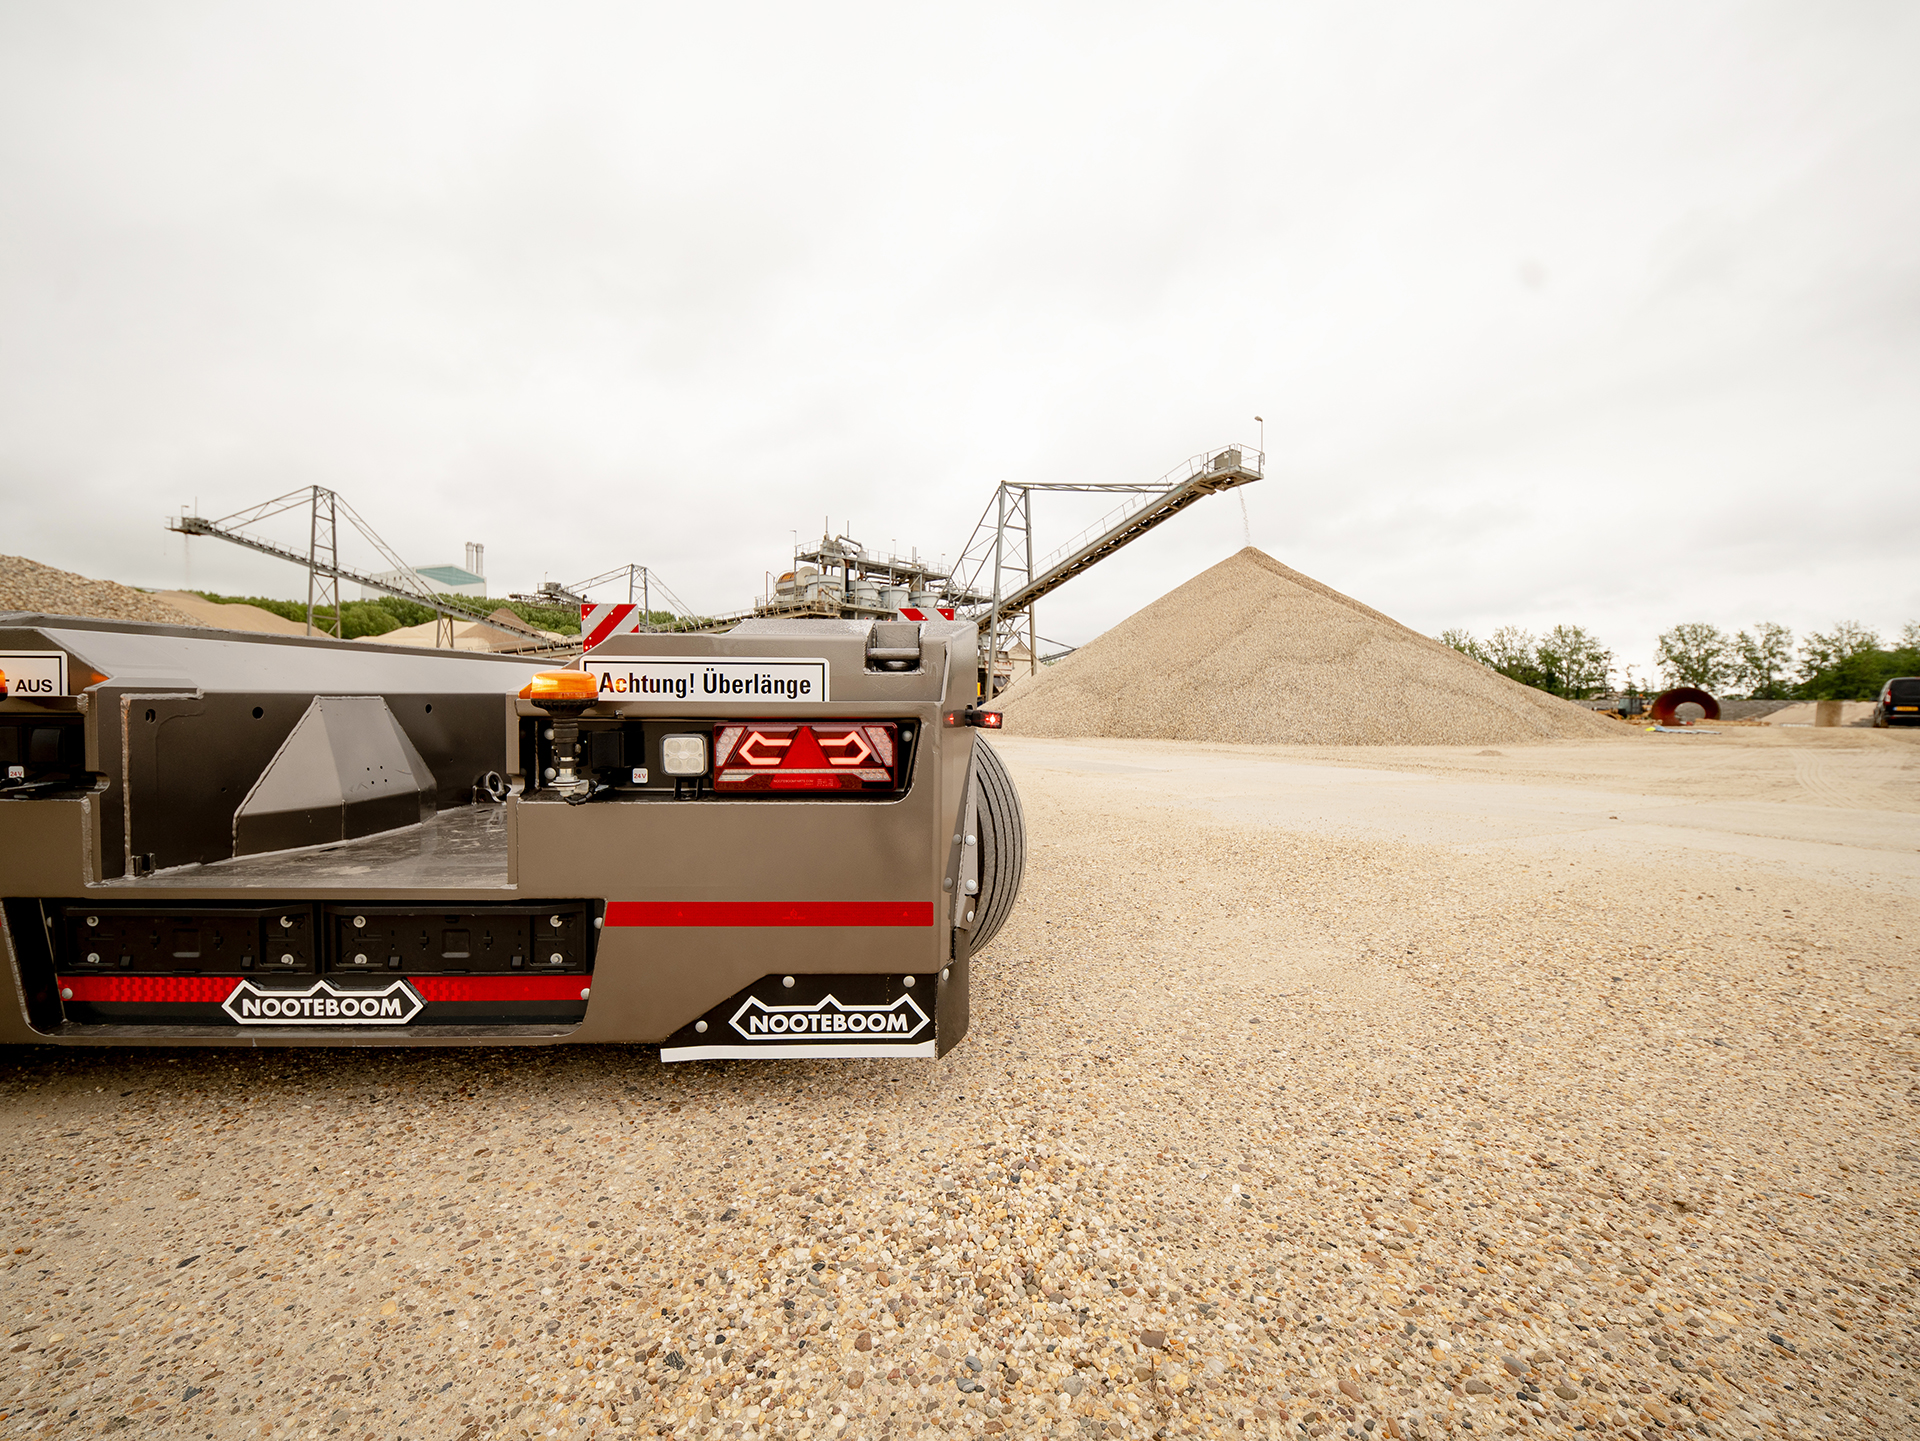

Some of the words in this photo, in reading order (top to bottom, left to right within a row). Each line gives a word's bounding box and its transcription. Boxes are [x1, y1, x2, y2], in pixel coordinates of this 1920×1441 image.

[15, 679, 53, 693] AUS
[599, 672, 695, 699] Achtung!
[703, 668, 812, 699] Überlänge
[242, 998, 402, 1017] NOOTEBOOM
[749, 1013, 909, 1033] NOOTEBOOM
